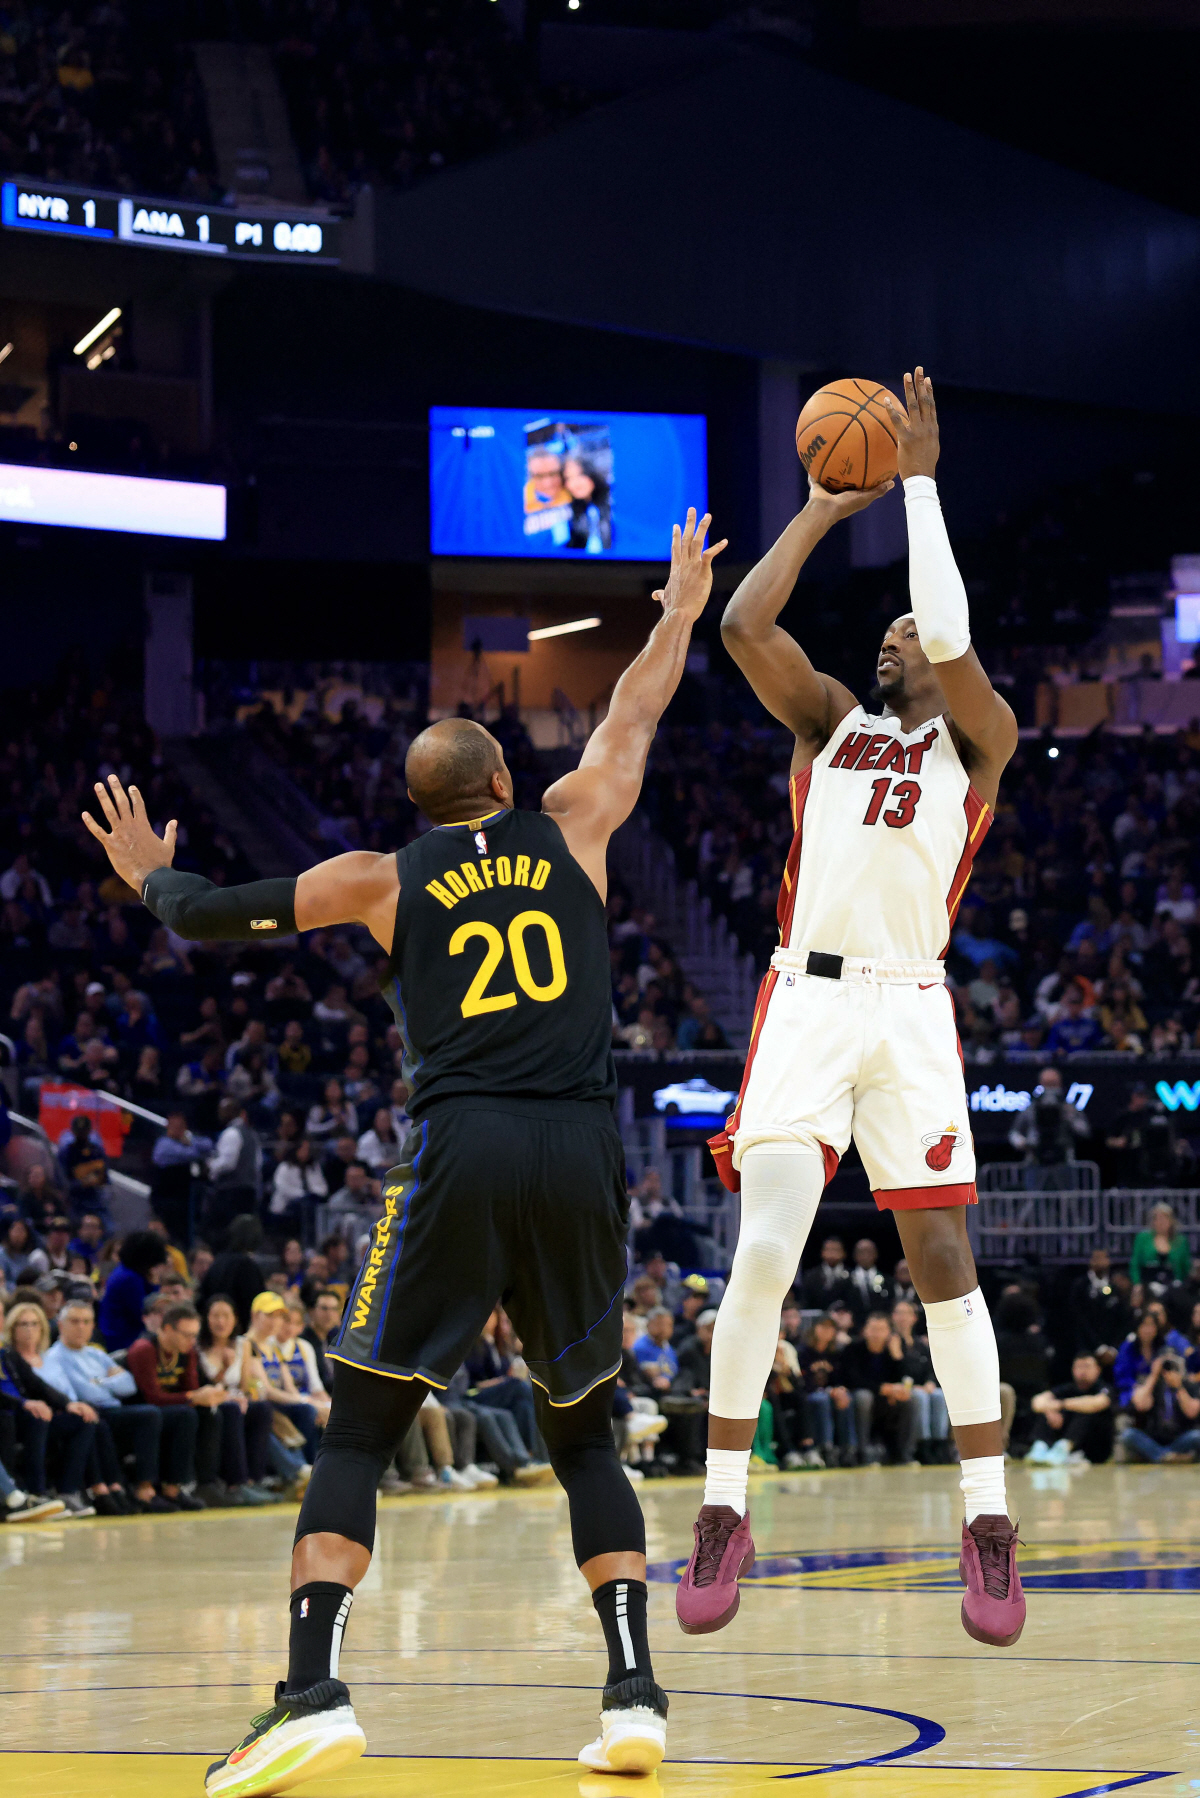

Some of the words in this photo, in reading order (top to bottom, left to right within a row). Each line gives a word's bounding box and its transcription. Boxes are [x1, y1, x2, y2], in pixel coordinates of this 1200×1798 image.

[18, 193, 69, 222] NYR
[83, 199, 96, 228] 1
[132, 208, 185, 237] ANA
[196, 214, 210, 242] 1
[235, 222, 263, 246] P1
[828, 728, 939, 775] HEAT
[862, 777, 922, 829] 13
[425, 855, 552, 909] HORFORD
[448, 910, 568, 1019] 20
[971, 1084, 1031, 1112] rides
[350, 1185, 404, 1329] WARRIORS
